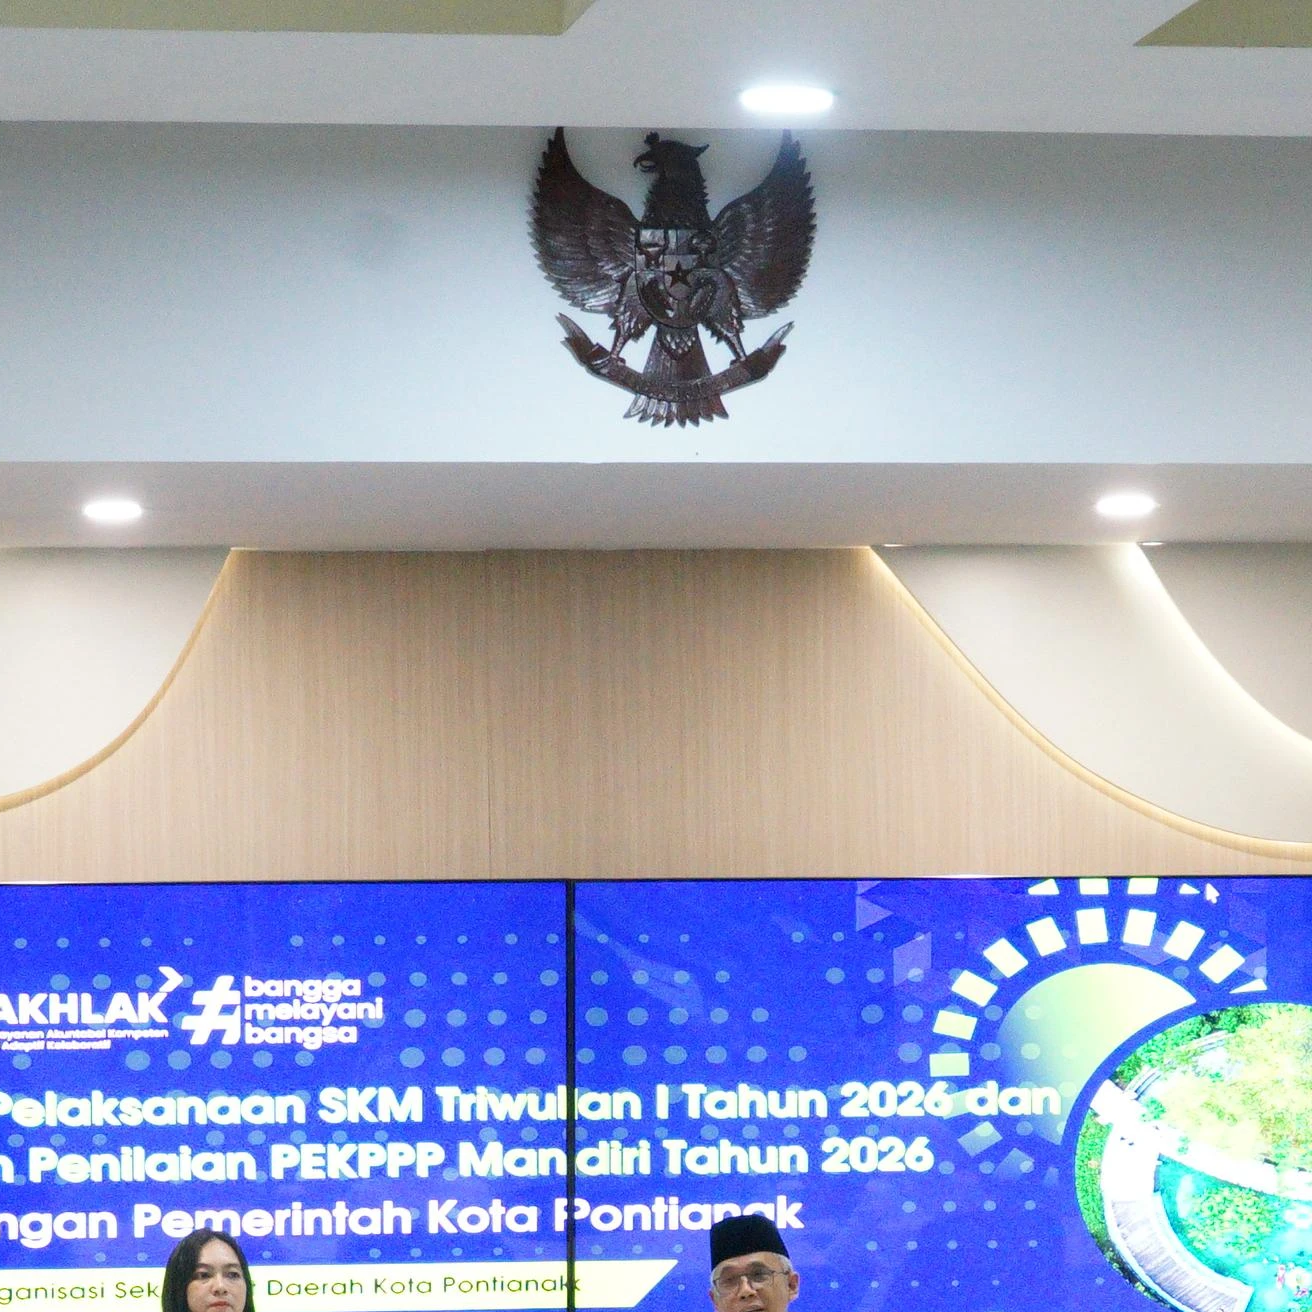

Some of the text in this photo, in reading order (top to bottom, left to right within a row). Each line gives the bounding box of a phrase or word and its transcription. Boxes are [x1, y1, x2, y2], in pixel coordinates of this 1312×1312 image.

[244, 975, 362, 1004] bangga
[244, 997, 383, 1026] melayani
[245, 1022, 358, 1050] bangsa
[318, 1086, 424, 1124] SKM
[656, 1085, 669, 1120] I
[681, 1083, 828, 1119] Tahun
[839, 1081, 953, 1118] 2026
[965, 1080, 1062, 1116] dan
[28, 1146, 258, 1184] Penilaian
[270, 1142, 446, 1180] PEKPPP
[458, 1140, 651, 1177] Mandiri
[661, 1138, 809, 1175] Tahun
[820, 1136, 935, 1173] 2026
[133, 1200, 412, 1239] Pemerintah
[427, 1199, 540, 1234] Kota
[267, 1278, 364, 1297] Daerah
[374, 1277, 433, 1295] Kota
